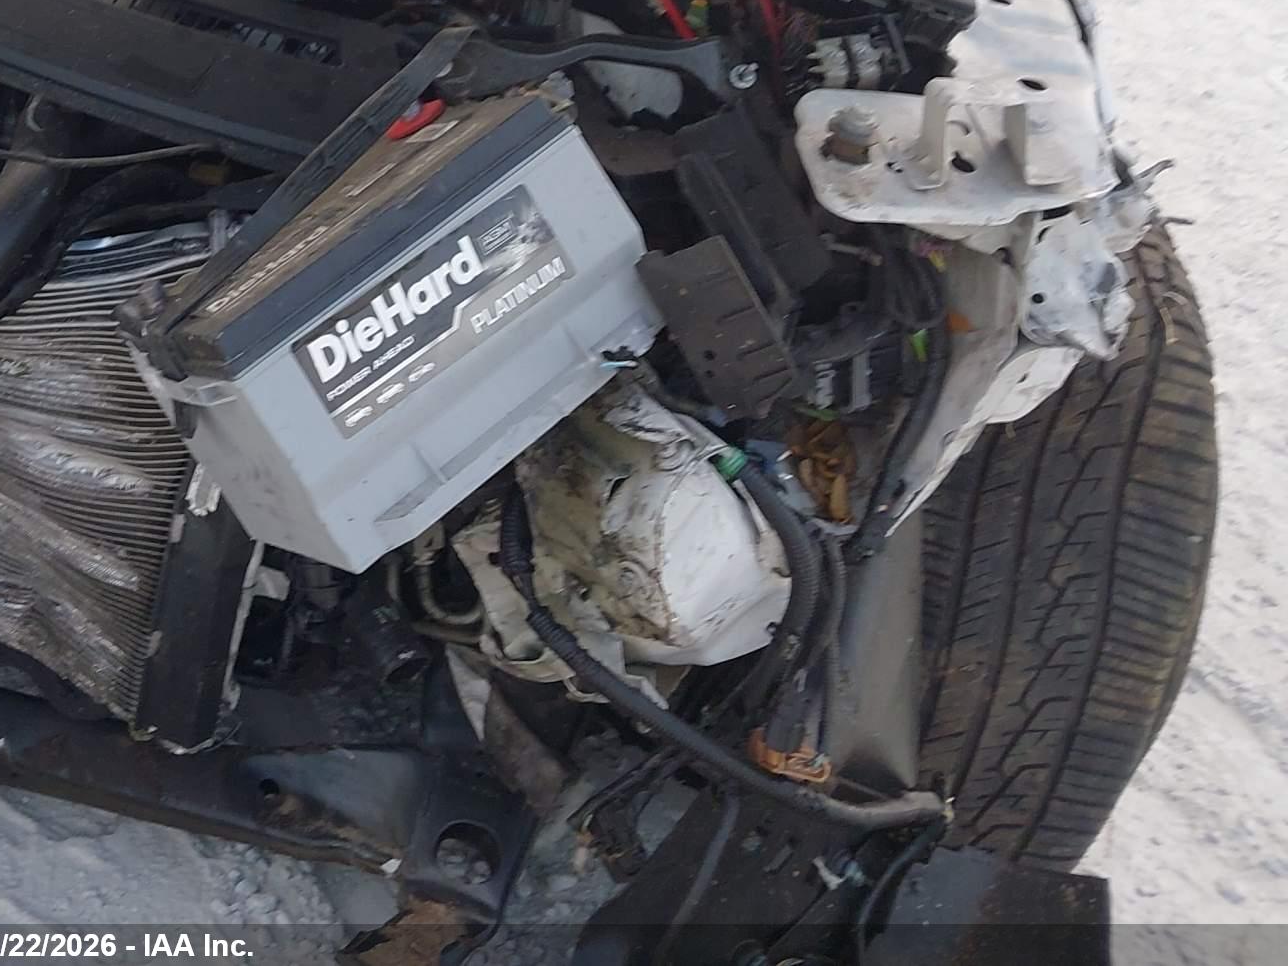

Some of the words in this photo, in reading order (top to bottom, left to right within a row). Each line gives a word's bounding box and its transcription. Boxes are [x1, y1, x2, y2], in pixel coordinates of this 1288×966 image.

[305, 234, 486, 384] DieHard
[470, 256, 568, 335] PLATINUM
[326, 365, 373, 402] POWER
[372, 336, 416, 371] AHEAD
